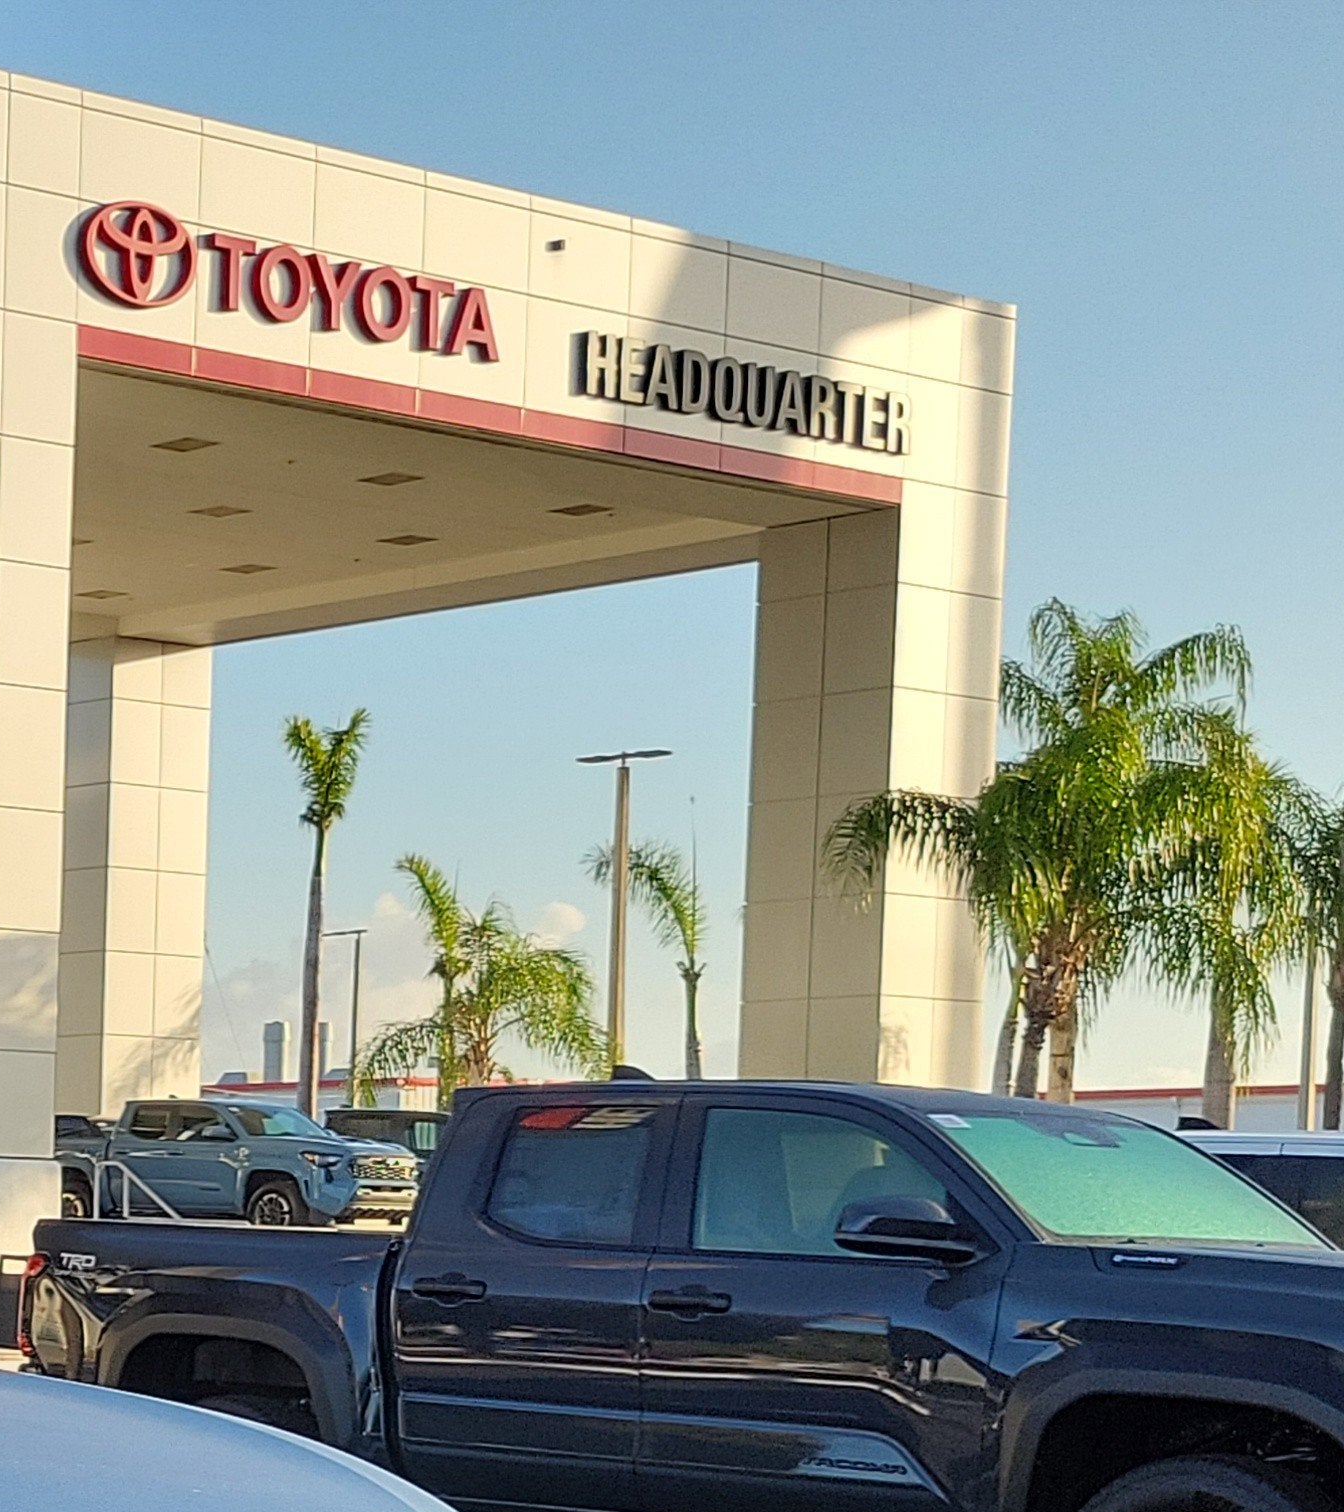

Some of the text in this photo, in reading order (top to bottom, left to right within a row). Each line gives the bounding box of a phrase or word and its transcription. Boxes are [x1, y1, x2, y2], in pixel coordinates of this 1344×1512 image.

[202, 231, 500, 363] TOYOTA
[580, 329, 911, 455] HEADQUARTER
[59, 1252, 97, 1270] TRD
